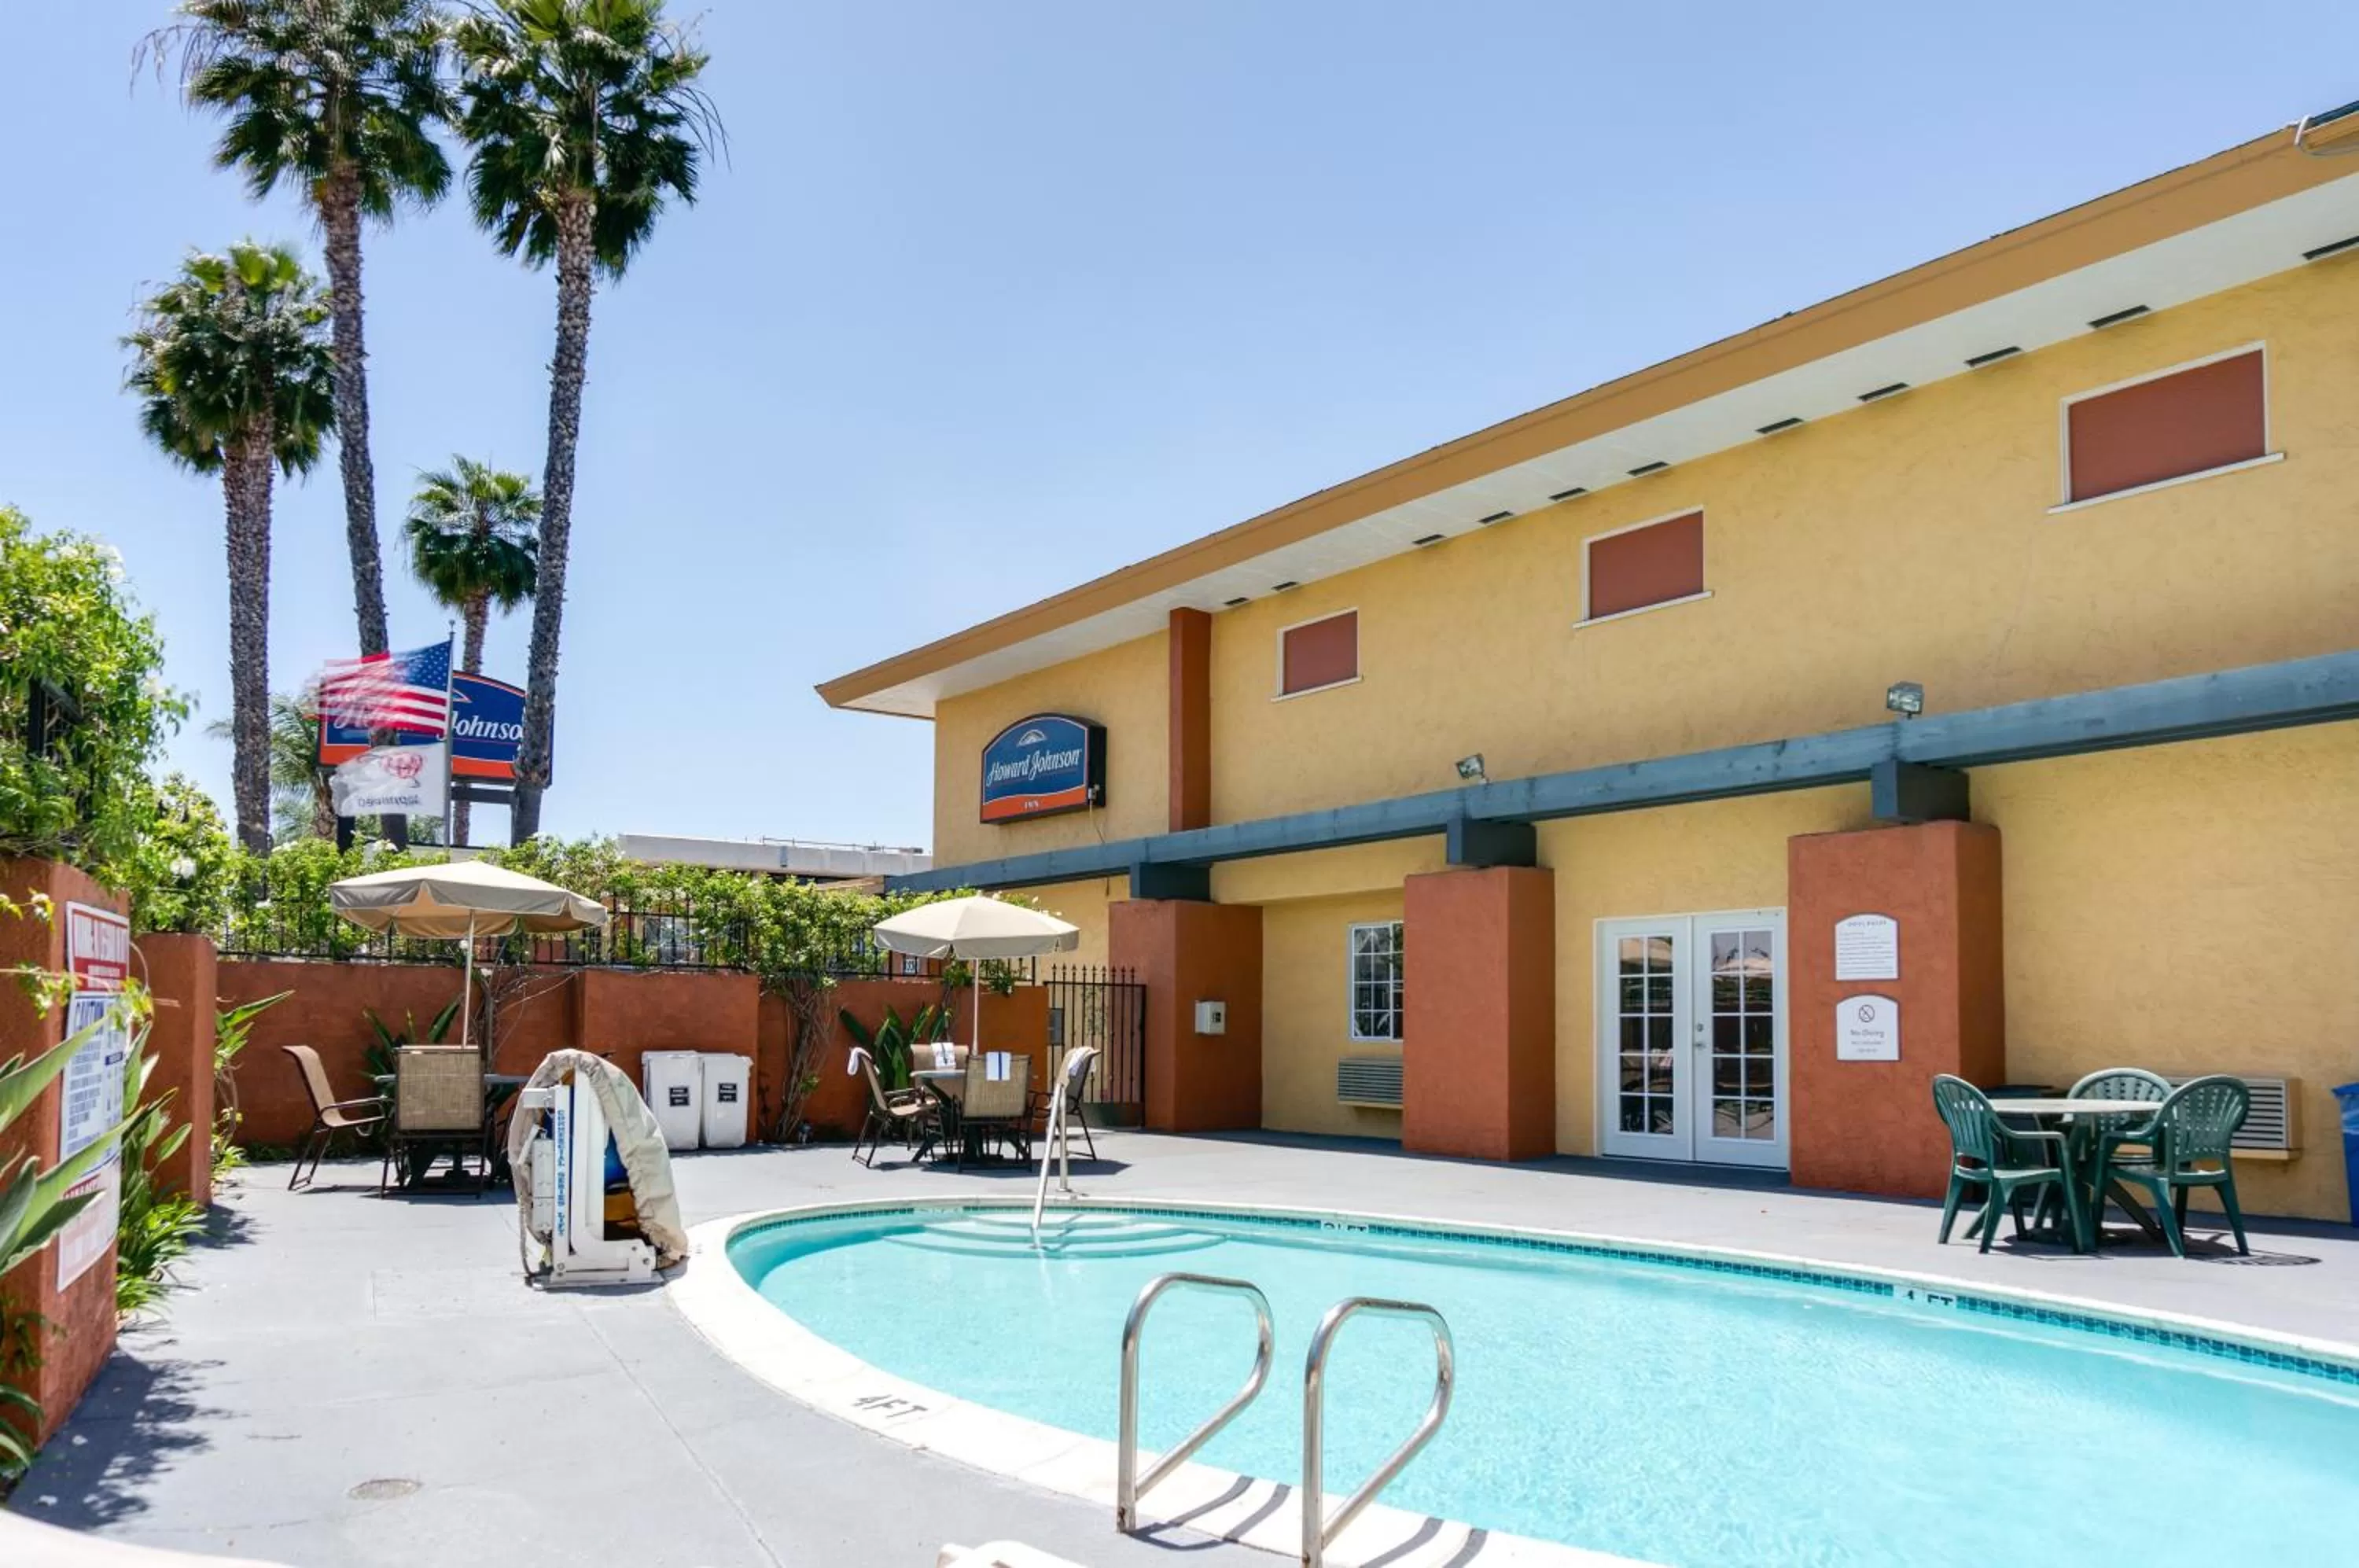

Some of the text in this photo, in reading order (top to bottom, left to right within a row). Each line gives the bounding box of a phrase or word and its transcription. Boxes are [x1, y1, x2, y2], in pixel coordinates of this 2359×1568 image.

[436, 710, 525, 741] Johnso
[986, 749, 1083, 787] Howard Johnson
[851, 1393, 929, 1418] 4FT
